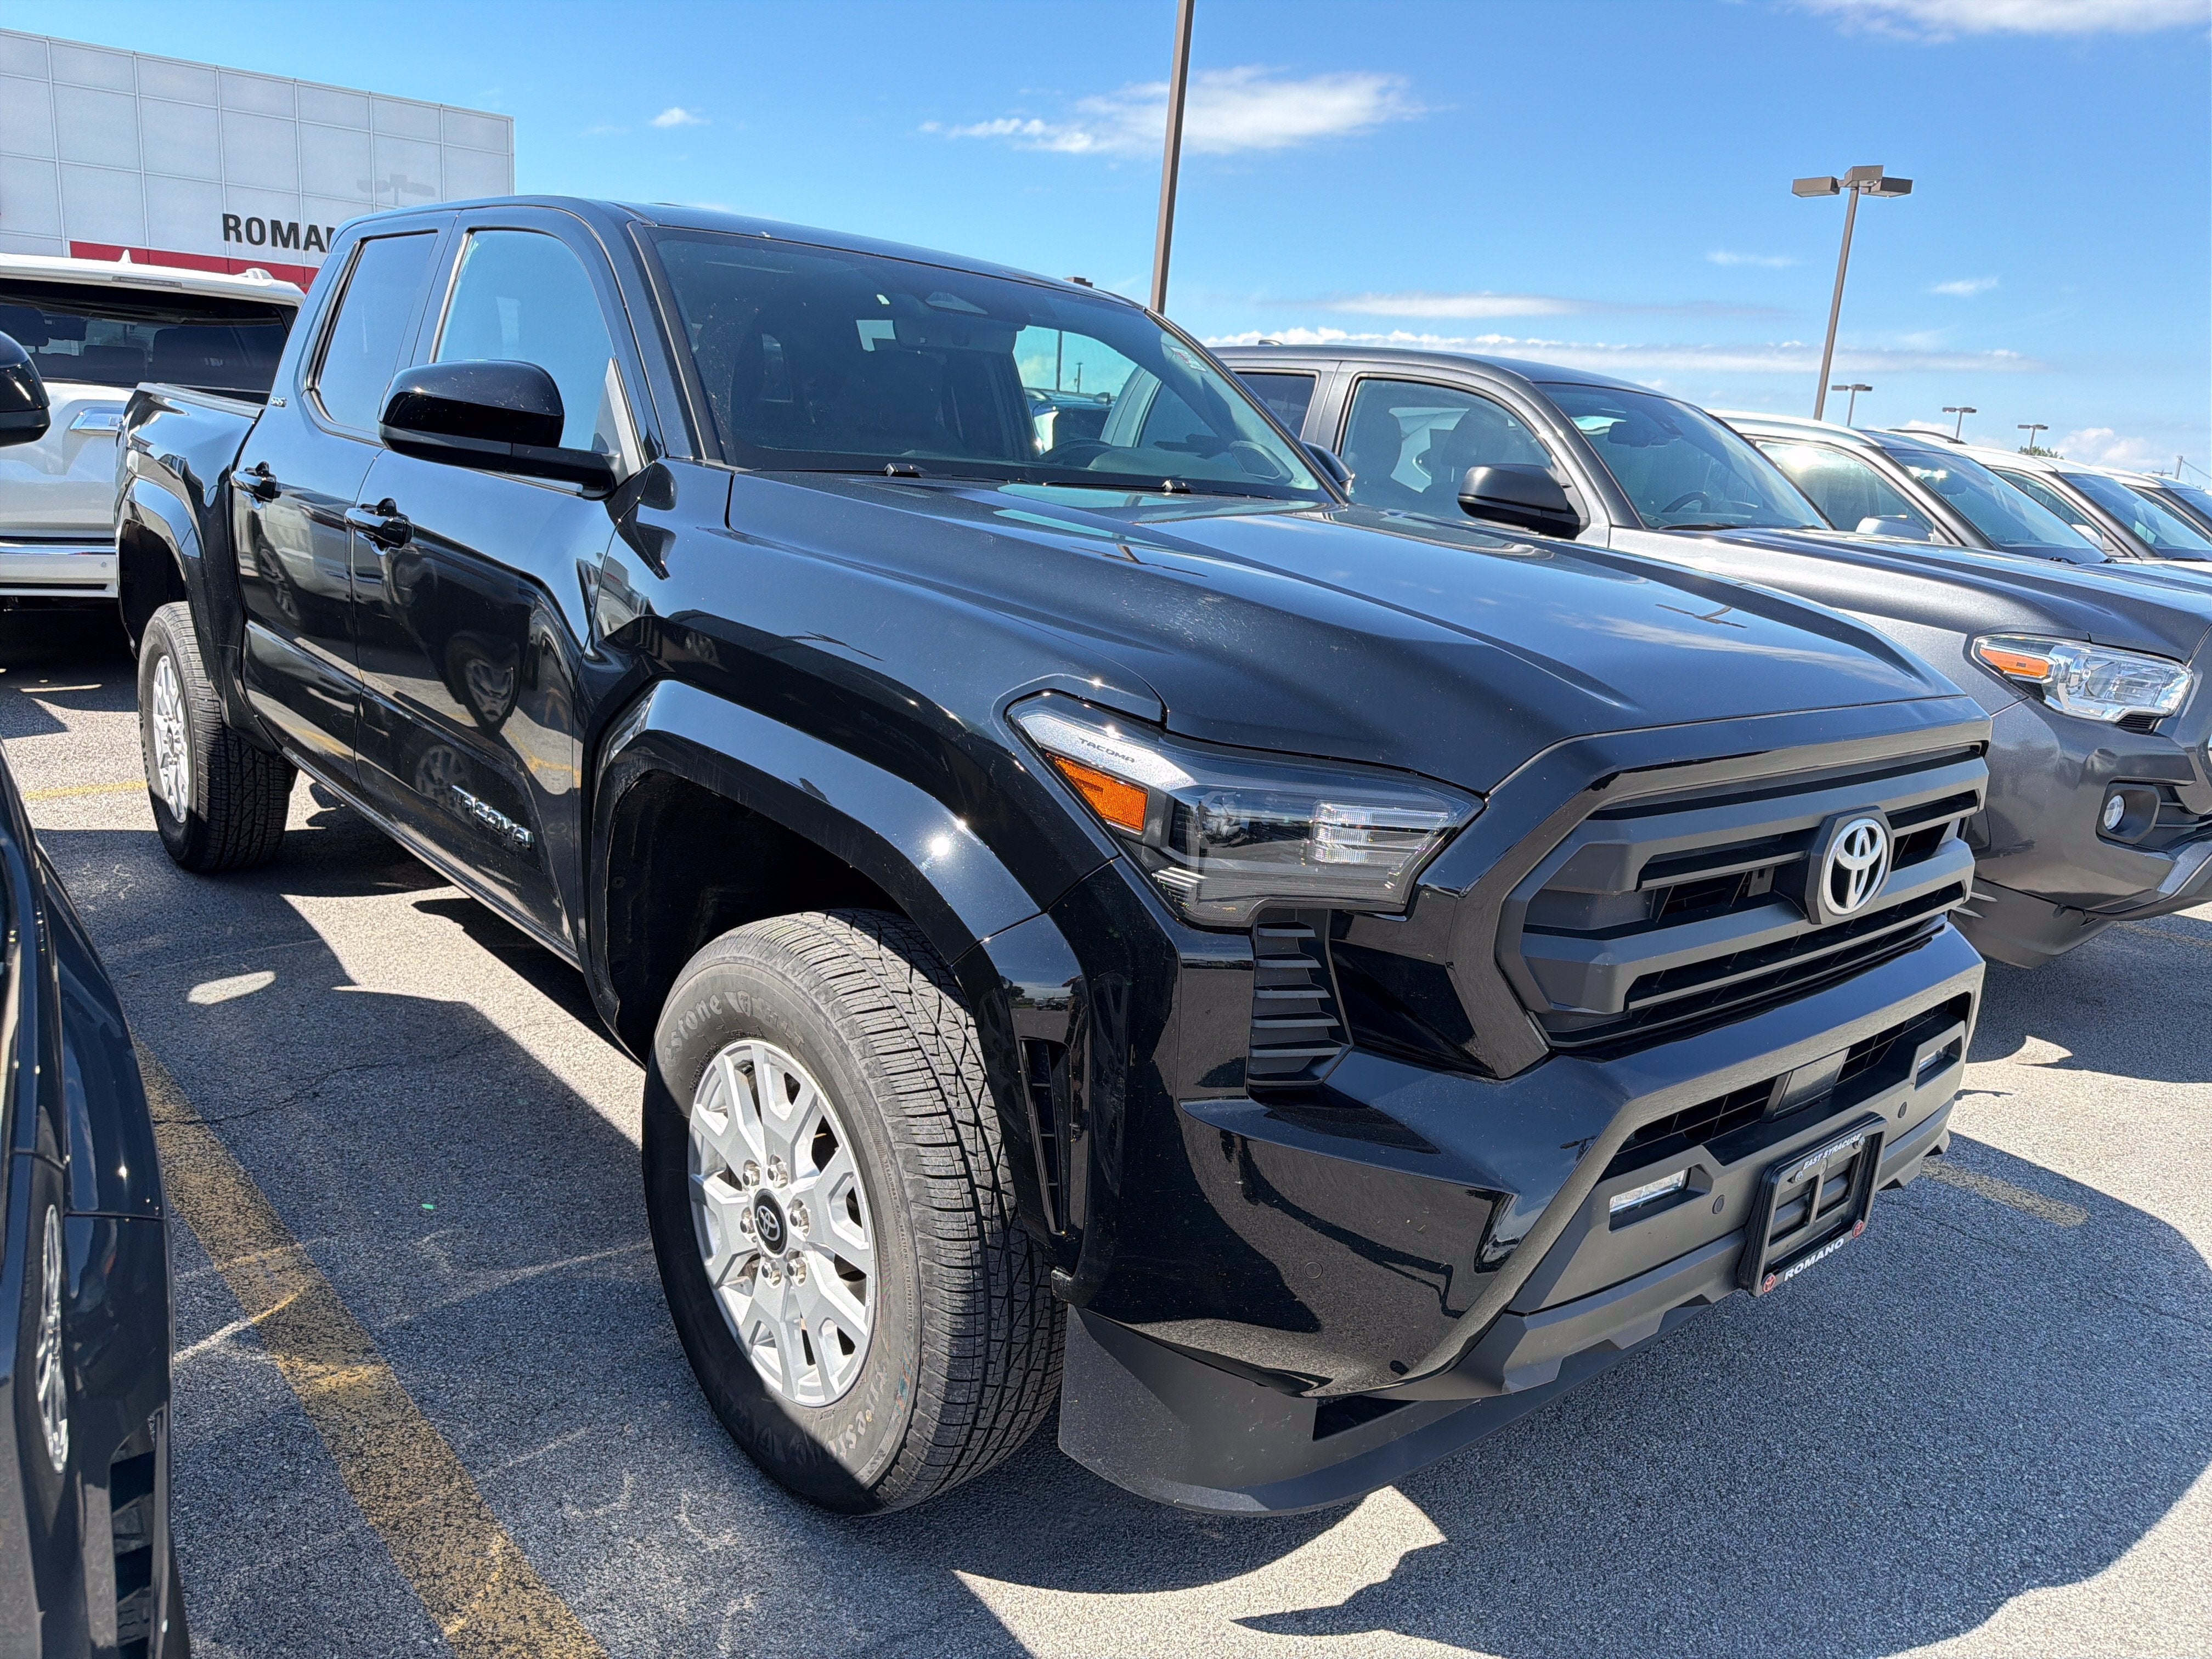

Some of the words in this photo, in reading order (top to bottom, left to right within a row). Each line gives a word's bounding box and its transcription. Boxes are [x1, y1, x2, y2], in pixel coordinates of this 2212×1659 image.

[1079, 737, 1135, 763] TACOMA
[452, 785, 534, 849] TACOMA
[1803, 1153, 1823, 1170] EAST
[1823, 1133, 1862, 1159] SYRACUSE
[900, 1225, 908, 1259] TRACTION
[1784, 1238, 1844, 1282] ROMANO
